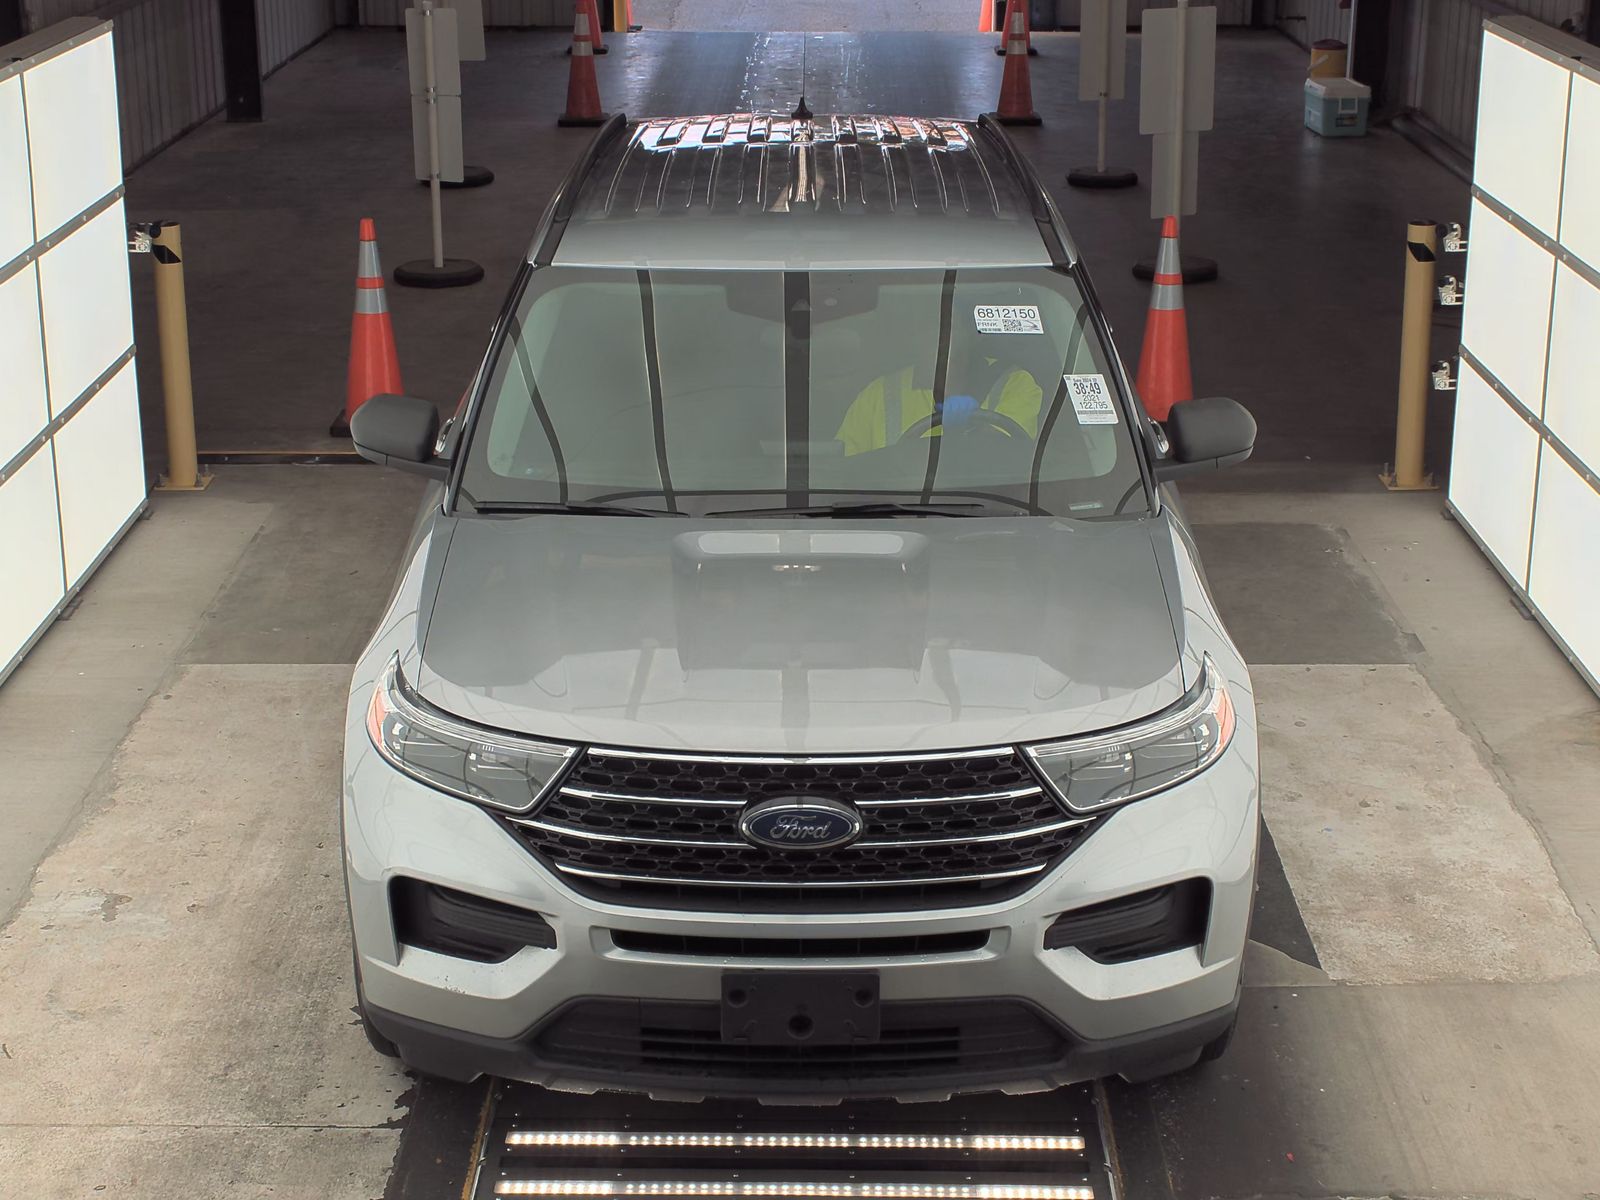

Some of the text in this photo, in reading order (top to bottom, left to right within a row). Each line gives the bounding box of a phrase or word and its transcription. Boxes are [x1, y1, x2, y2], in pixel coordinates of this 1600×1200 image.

[977, 308, 1036, 319] 6812150
[1073, 383, 1102, 395] 38:49
[1082, 394, 1100, 402] 2021
[770, 814, 832, 839] Ford
